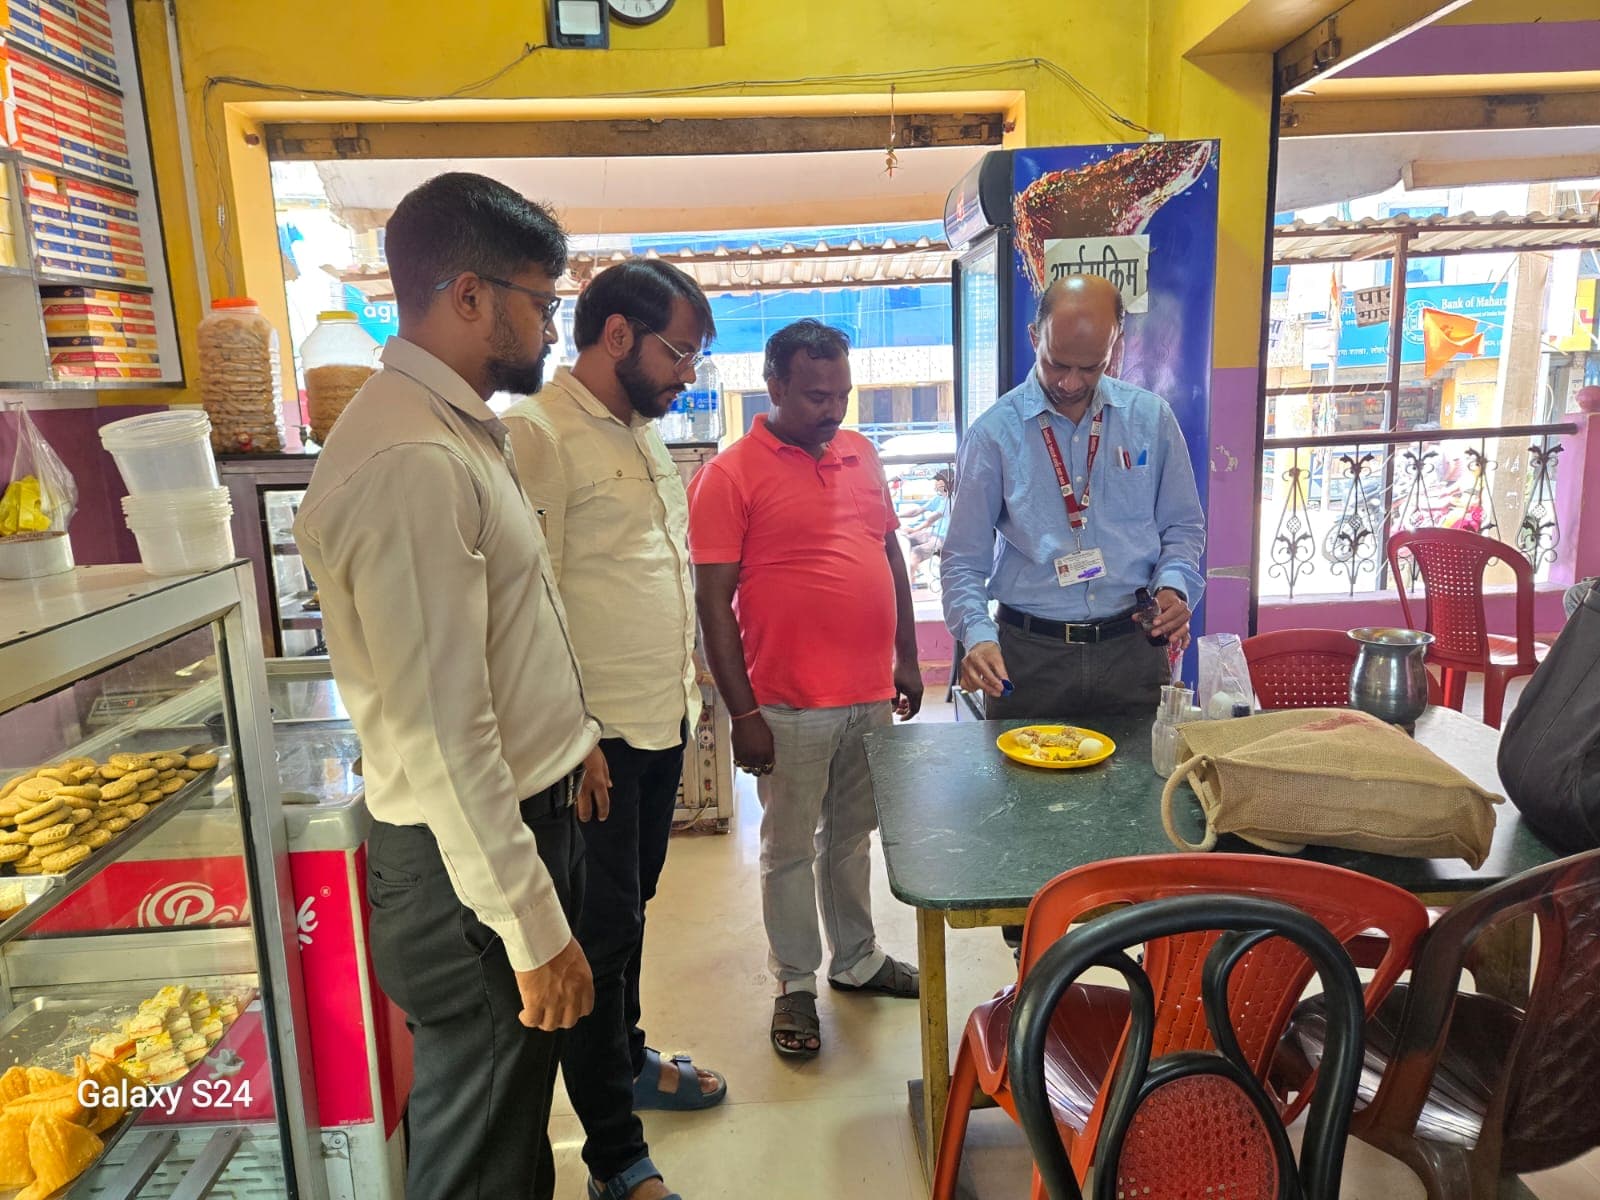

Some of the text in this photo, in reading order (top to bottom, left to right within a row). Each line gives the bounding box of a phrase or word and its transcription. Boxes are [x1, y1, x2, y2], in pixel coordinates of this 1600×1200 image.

[1441, 294, 1508, 310] Bank of Mahar
